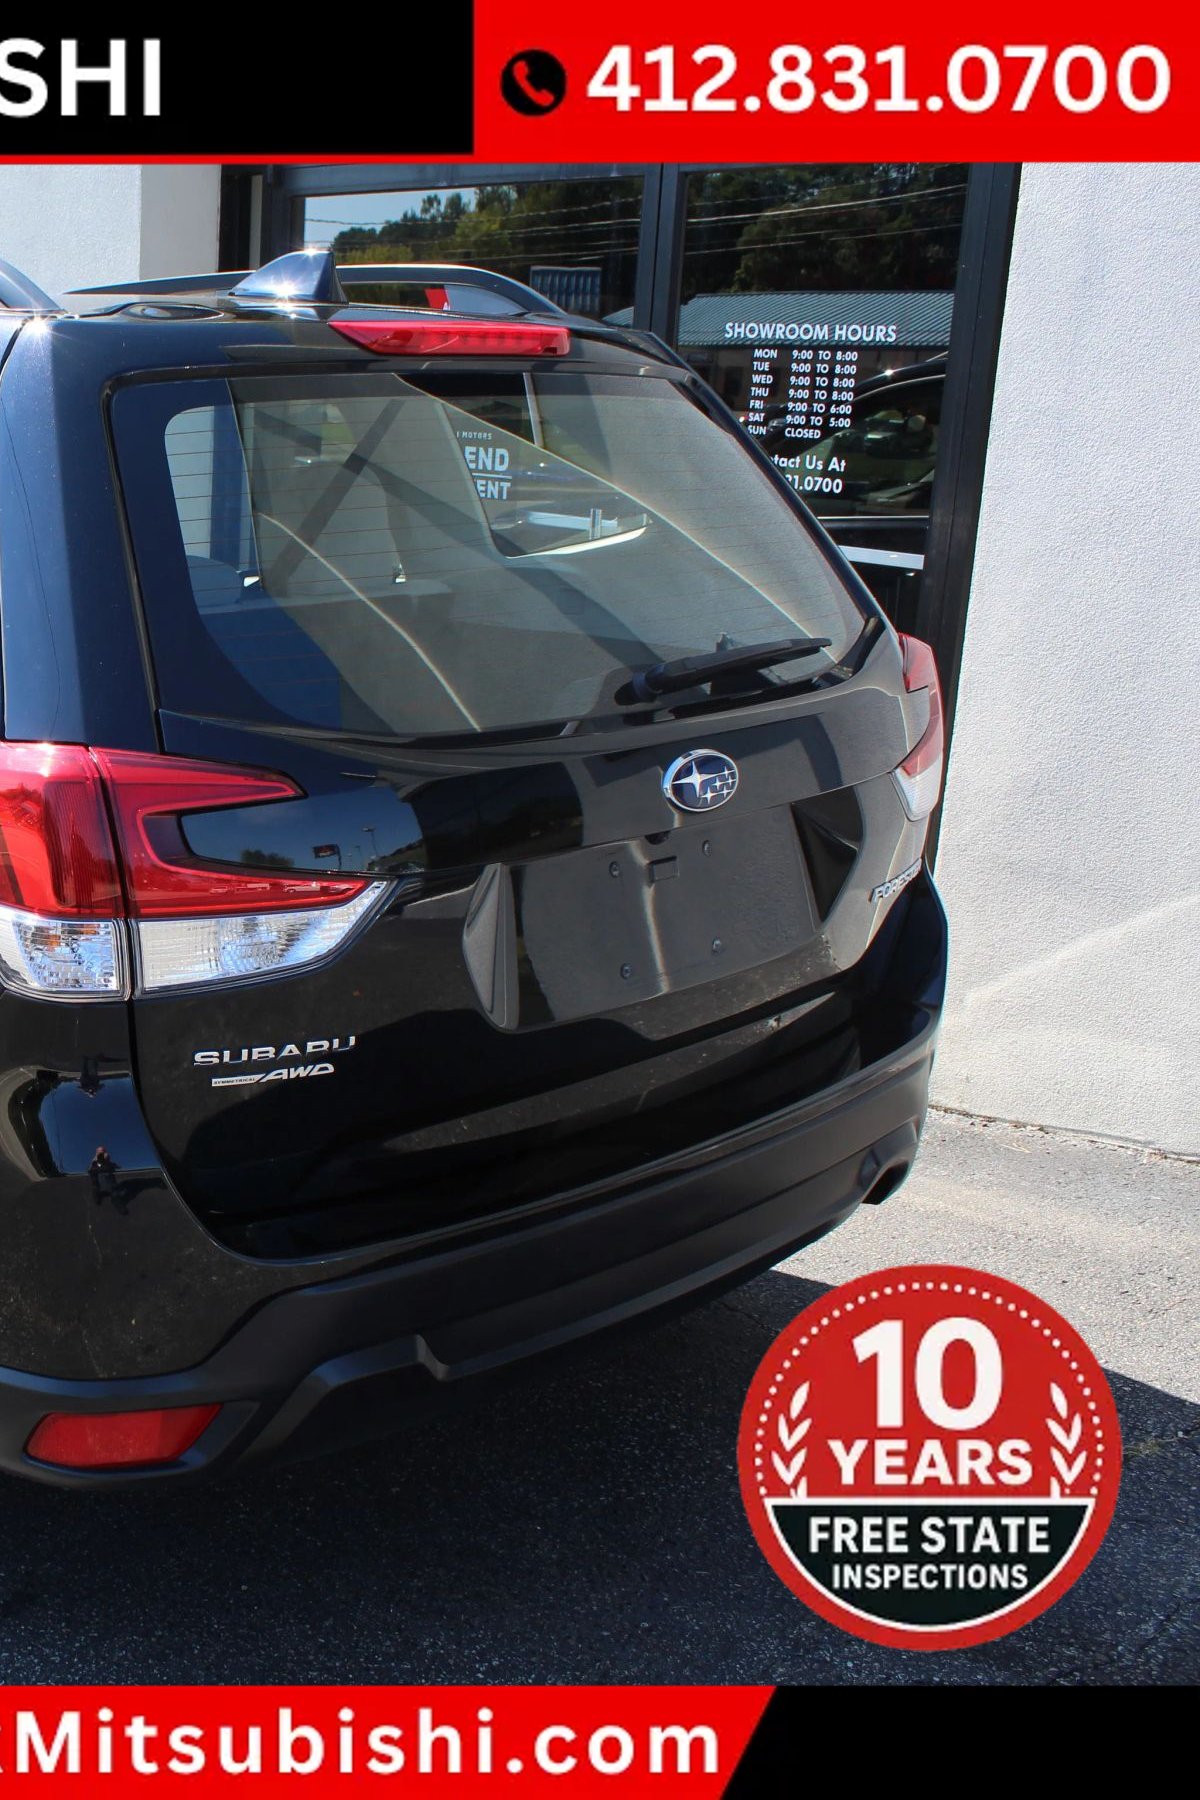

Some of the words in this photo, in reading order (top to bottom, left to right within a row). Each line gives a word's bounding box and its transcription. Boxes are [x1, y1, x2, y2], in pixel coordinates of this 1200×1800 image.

[725, 322, 828, 342] SHOWROOM
[834, 325, 897, 342] HOURS
[754, 349, 778, 359] MON
[792, 350, 813, 361] 9:00
[818, 351, 831, 361] TO
[836, 351, 858, 362] 8:00
[753, 361, 770, 372] TUE
[791, 363, 811, 374] 9:00
[816, 364, 829, 375] TO
[835, 364, 857, 375] 8:00
[752, 374, 773, 384] WED
[789, 376, 810, 387] 9:00
[815, 376, 828, 387] TO
[833, 377, 855, 388] 8:00
[751, 387, 769, 397] THU
[788, 388, 809, 399] 9:00
[814, 389, 827, 400] TO
[831, 390, 854, 401] 8:00
[749, 399, 764, 409] FRI
[787, 401, 808, 412] 9:00
[813, 402, 826, 413] TO
[830, 403, 852, 414] 6:00
[748, 412, 764, 422] SAT
[786, 414, 806, 425] 9:00
[810, 415, 823, 426] TO
[829, 416, 851, 427] 5:00
[462, 431, 493, 440] MOTORS
[747, 425, 767, 435] SUN
[785, 427, 821, 439] CLOSED
[770, 454, 801, 468] tact
[805, 454, 824, 470] Us
[827, 456, 847, 472] At
[476, 479, 512, 500] ENT
[193, 1035, 356, 1066] SUBARU
[259, 1062, 336, 1083] AWD
